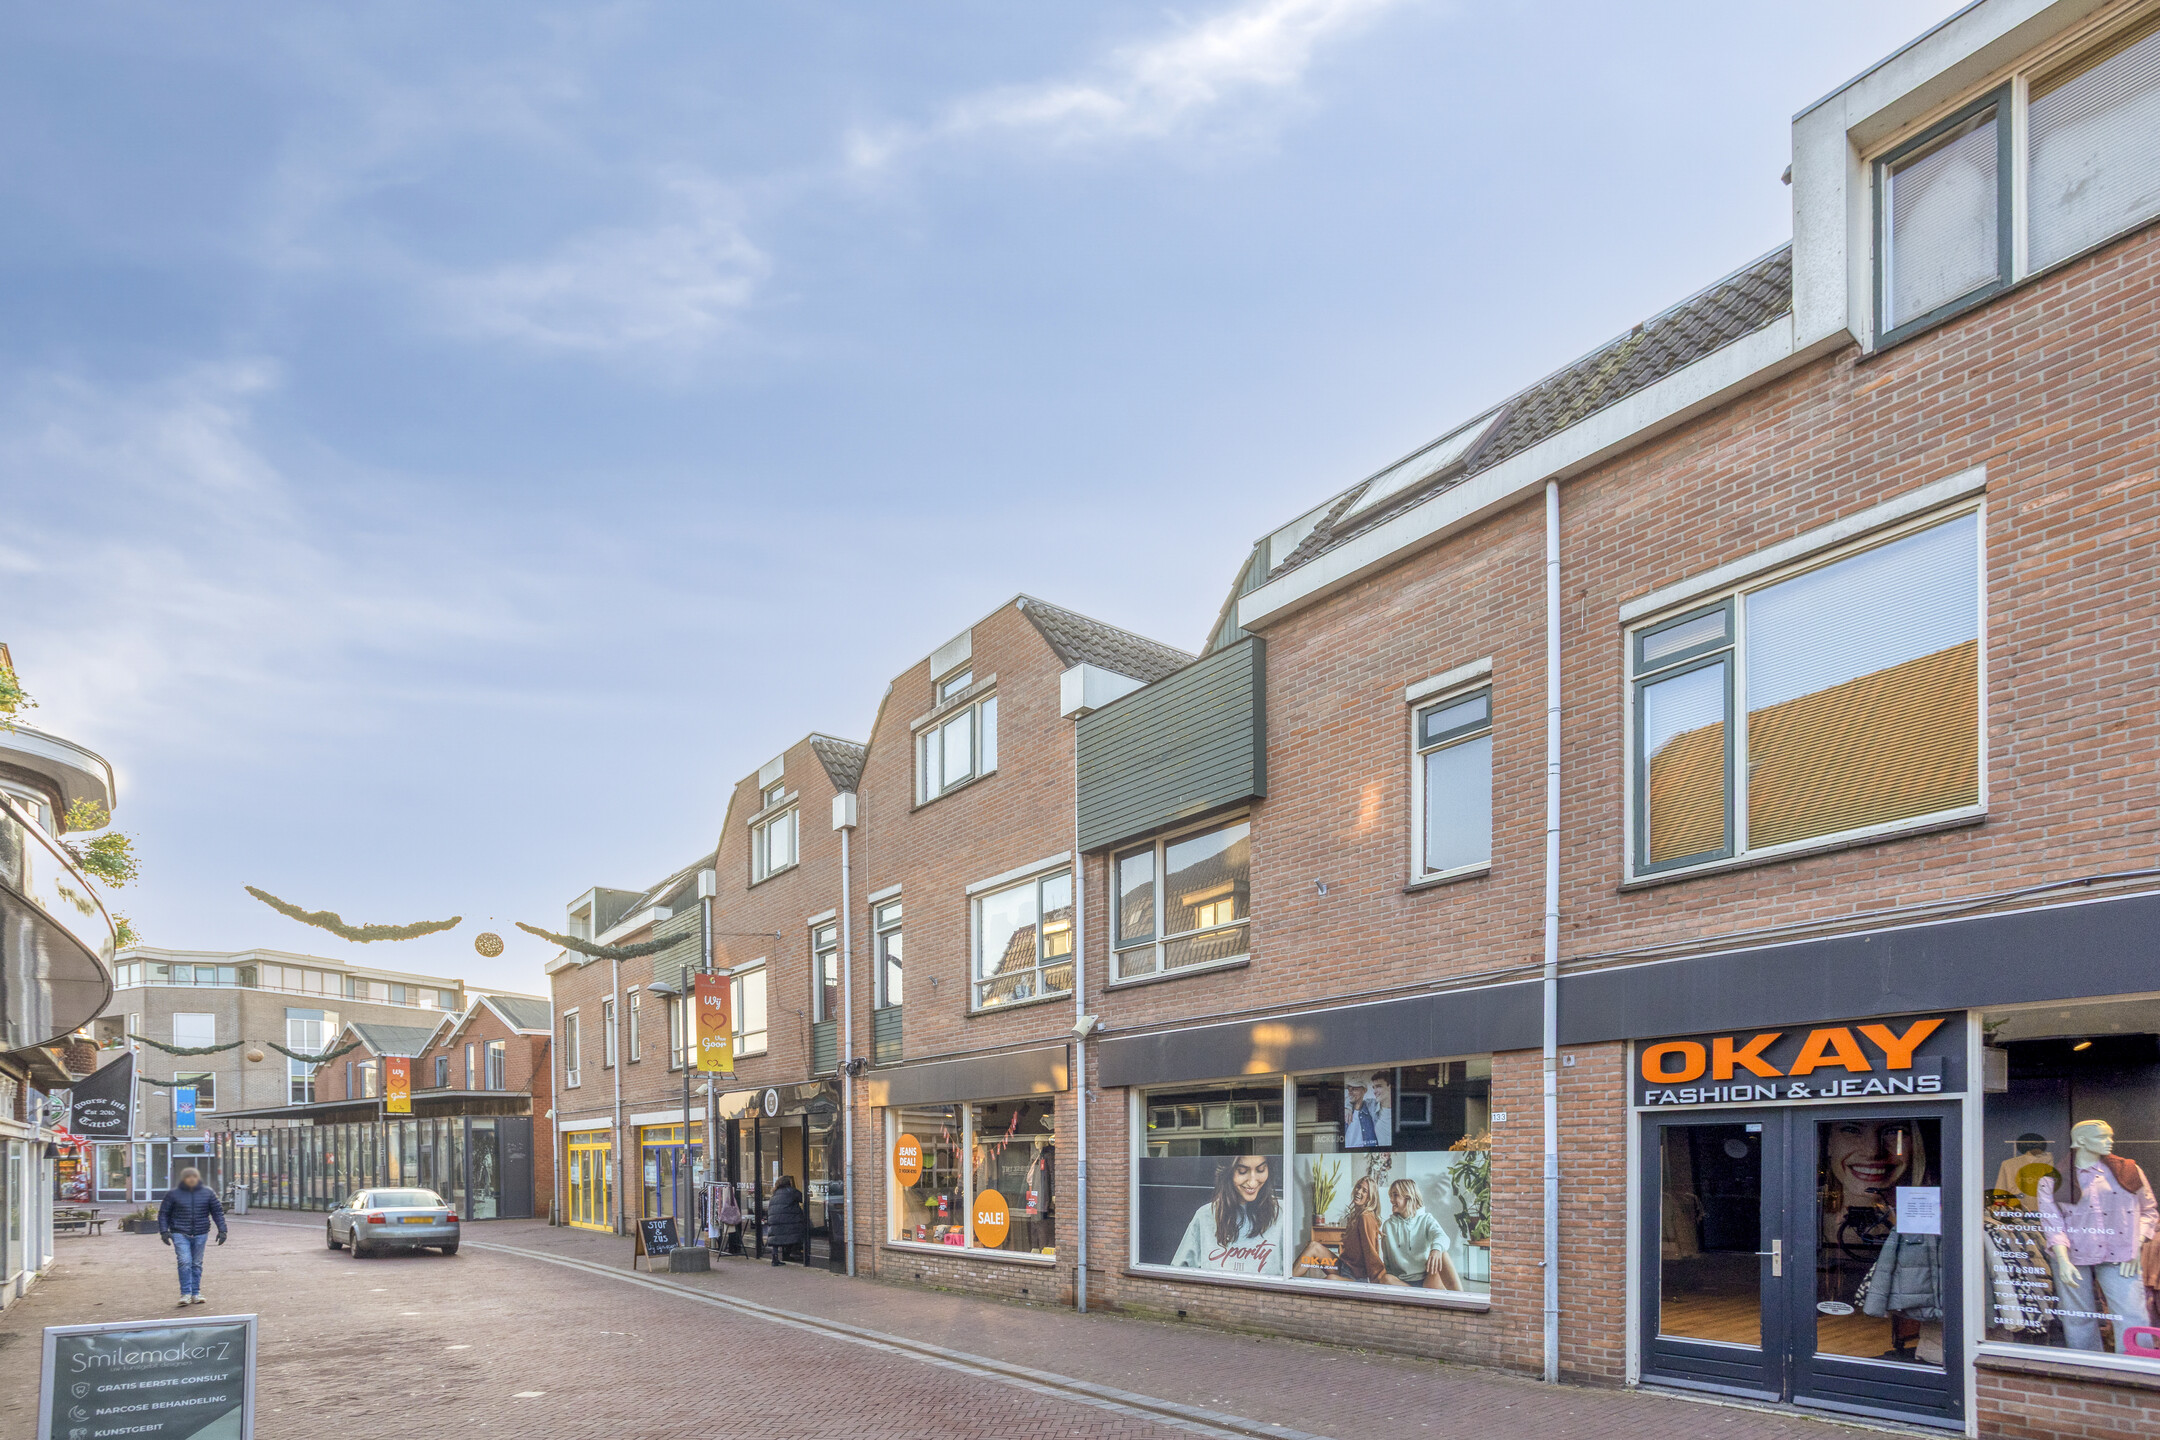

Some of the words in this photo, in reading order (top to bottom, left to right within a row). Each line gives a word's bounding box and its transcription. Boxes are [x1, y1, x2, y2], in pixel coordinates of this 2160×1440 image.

[702, 1037, 727, 1052] Goor
[1641, 1018, 1946, 1084] OKAY
[1645, 1083, 1777, 1105] FASHION
[1787, 1082, 1813, 1099] &
[1820, 1075, 1942, 1097] JEANS
[79, 1116, 121, 1128] Tattoo
[1492, 1113, 1506, 1121] 133
[899, 1147, 917, 1156] JEANS
[899, 1157, 916, 1166] DEAL!
[977, 1211, 1004, 1225] SALE!
[2024, 1211, 2058, 1219] MODA
[648, 1220, 667, 1229] STOF
[1993, 1224, 2063, 1233] JACQUELINE
[2081, 1227, 2115, 1235] YONG
[653, 1235, 669, 1243] ZUS
[1208, 1240, 1276, 1273] Sporty
[1301, 1255, 1338, 1266] OKAY
[1993, 1265, 2013, 1273] ONLY
[2022, 1266, 2046, 1275] SONS
[1994, 1291, 2017, 1299] TOM
[2018, 1293, 2060, 1302] TAILOR
[1993, 1303, 2042, 1313] PETROL
[2044, 1308, 2124, 1321] INDUSTRIES
[1993, 1316, 2015, 1326] CARS
[2016, 1318, 2041, 1328] JEANS
[97, 1382, 137, 1392] GRATIS
[139, 1378, 178, 1389] EERSTE
[181, 1373, 229, 1384] CONSULT
[96, 1403, 149, 1416] NARCOSE
[151, 1395, 227, 1410] BEHANDELING
[94, 1423, 164, 1437] KUNSTGEBIT
